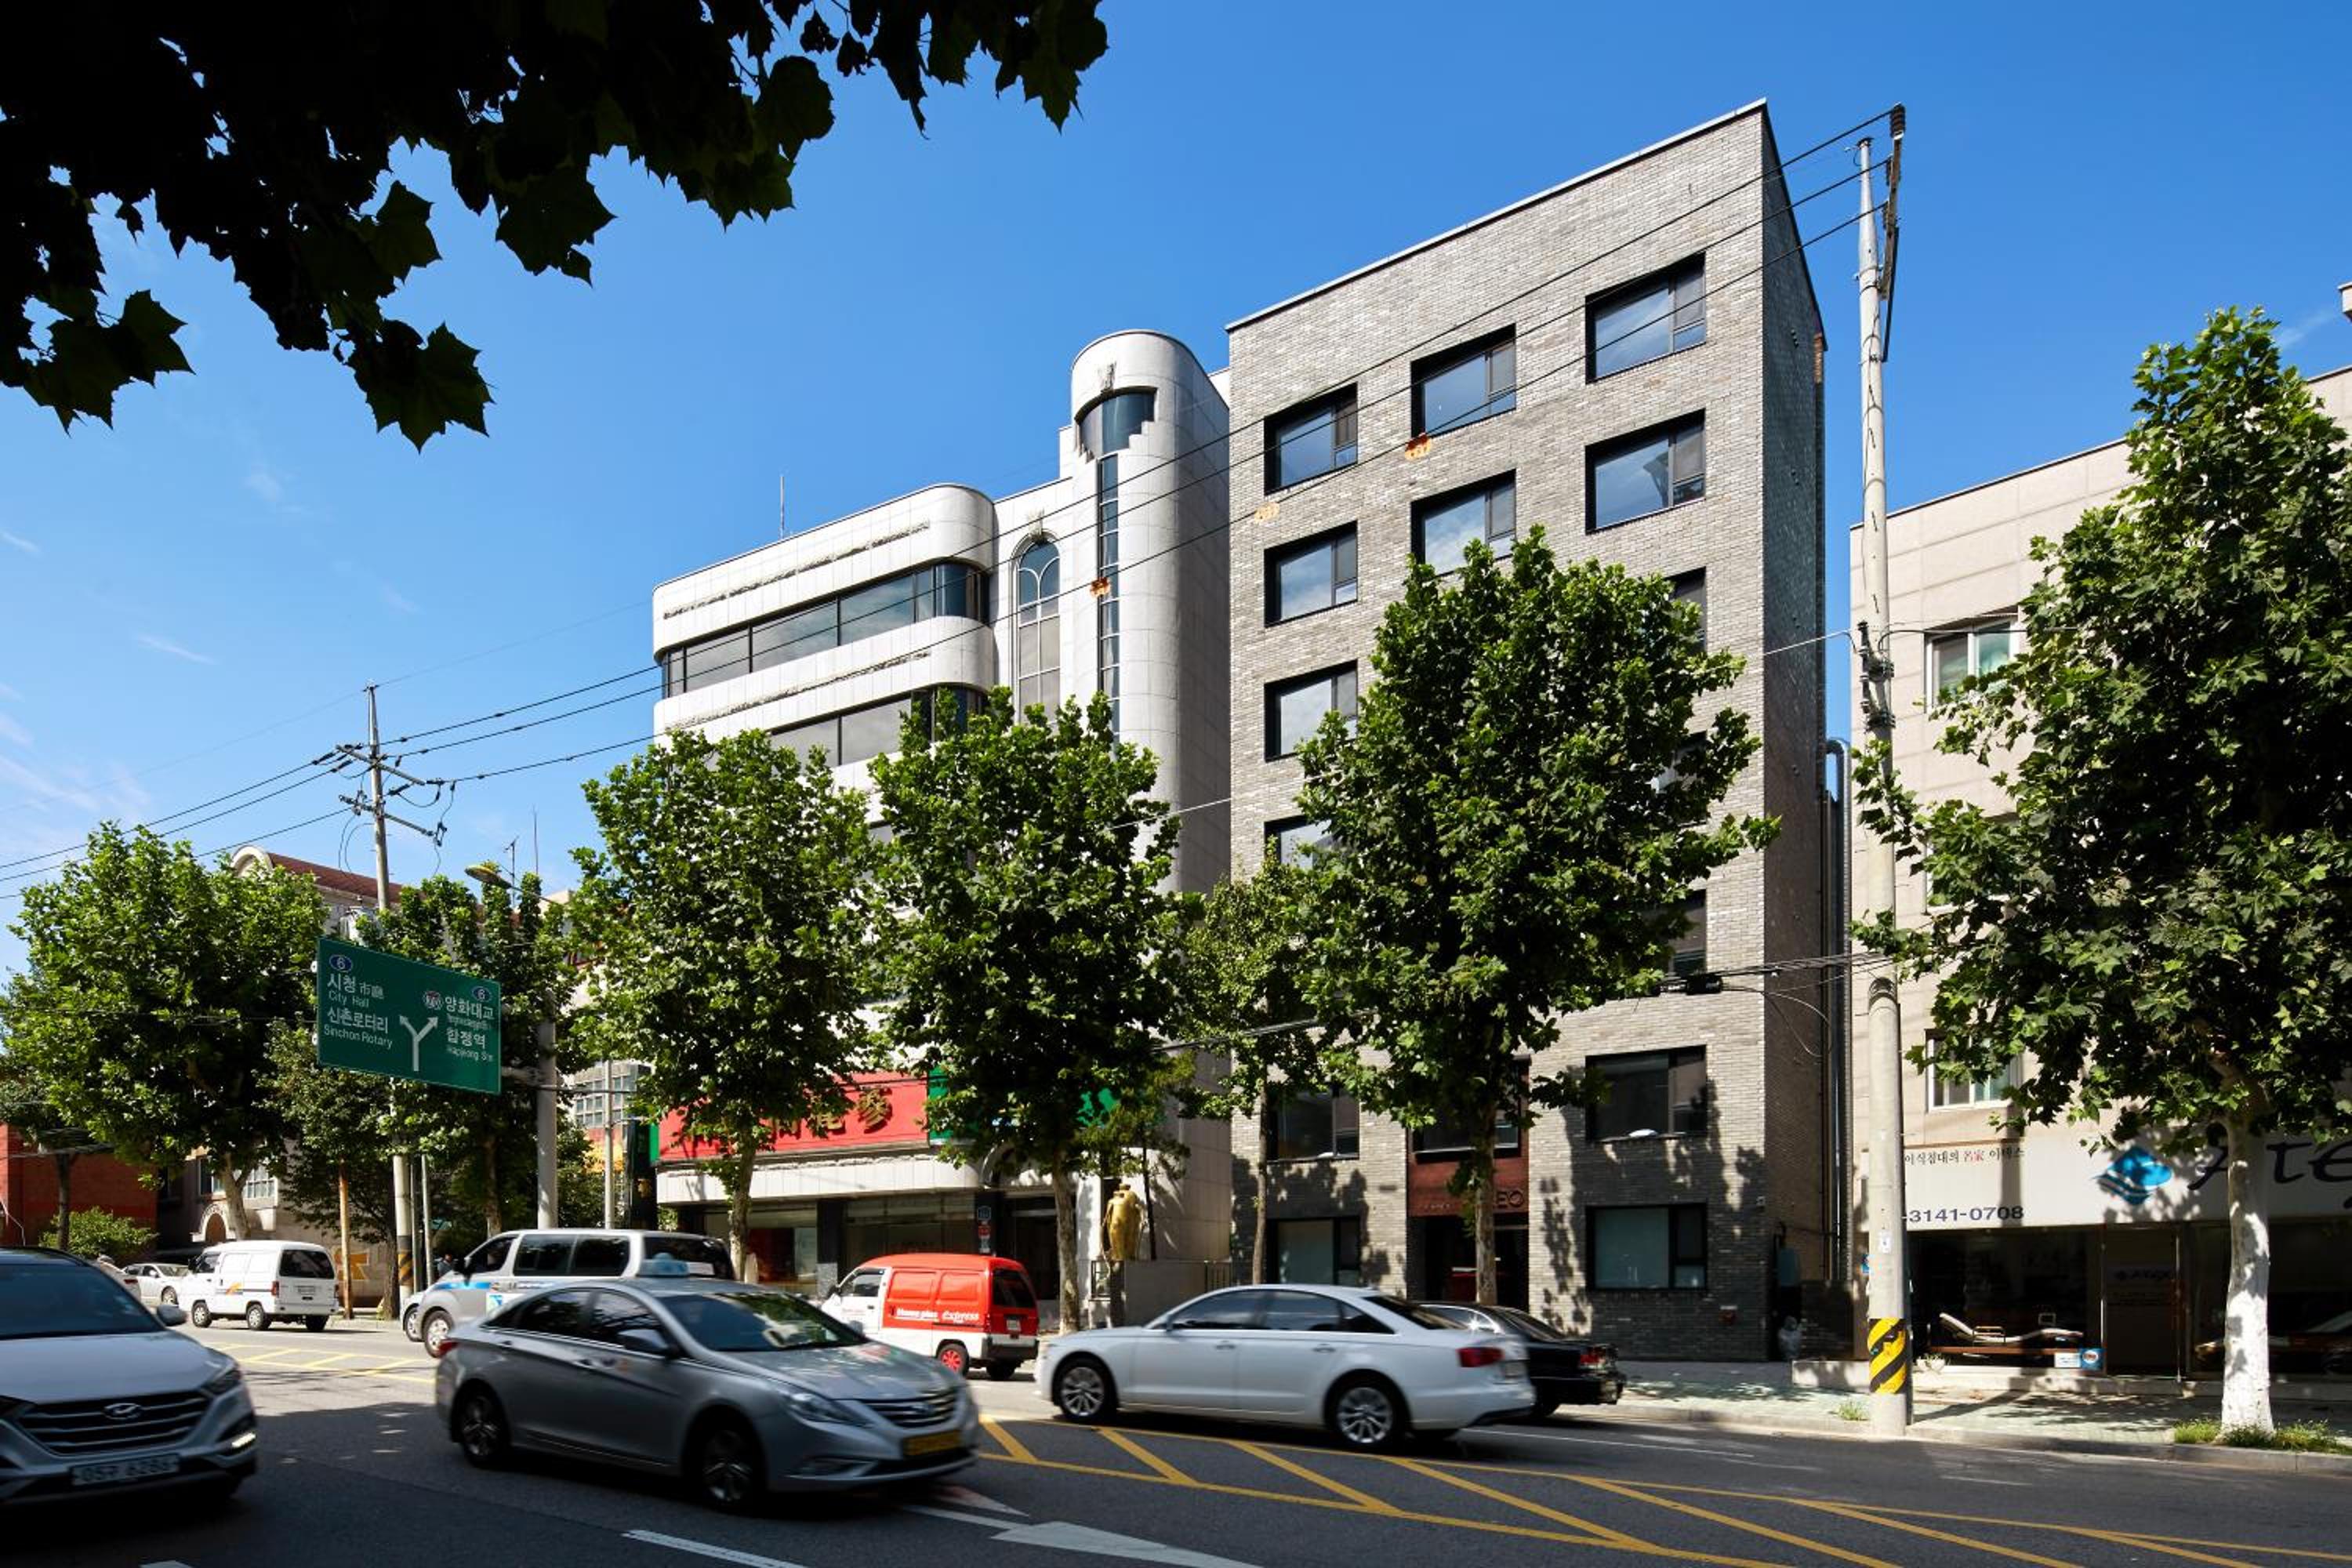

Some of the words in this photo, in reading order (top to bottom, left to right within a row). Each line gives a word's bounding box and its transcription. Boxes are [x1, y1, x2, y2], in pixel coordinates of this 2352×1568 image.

[327, 973, 356, 993] 시청
[328, 991, 347, 1006] City
[352, 996, 369, 1008] Hall
[445, 996, 494, 1020] 양화대교
[327, 1007, 388, 1034] 신촌로터리
[324, 1024, 361, 1041] Sinchon
[361, 1032, 393, 1050] Rotary
[446, 1027, 485, 1049] 합정역
